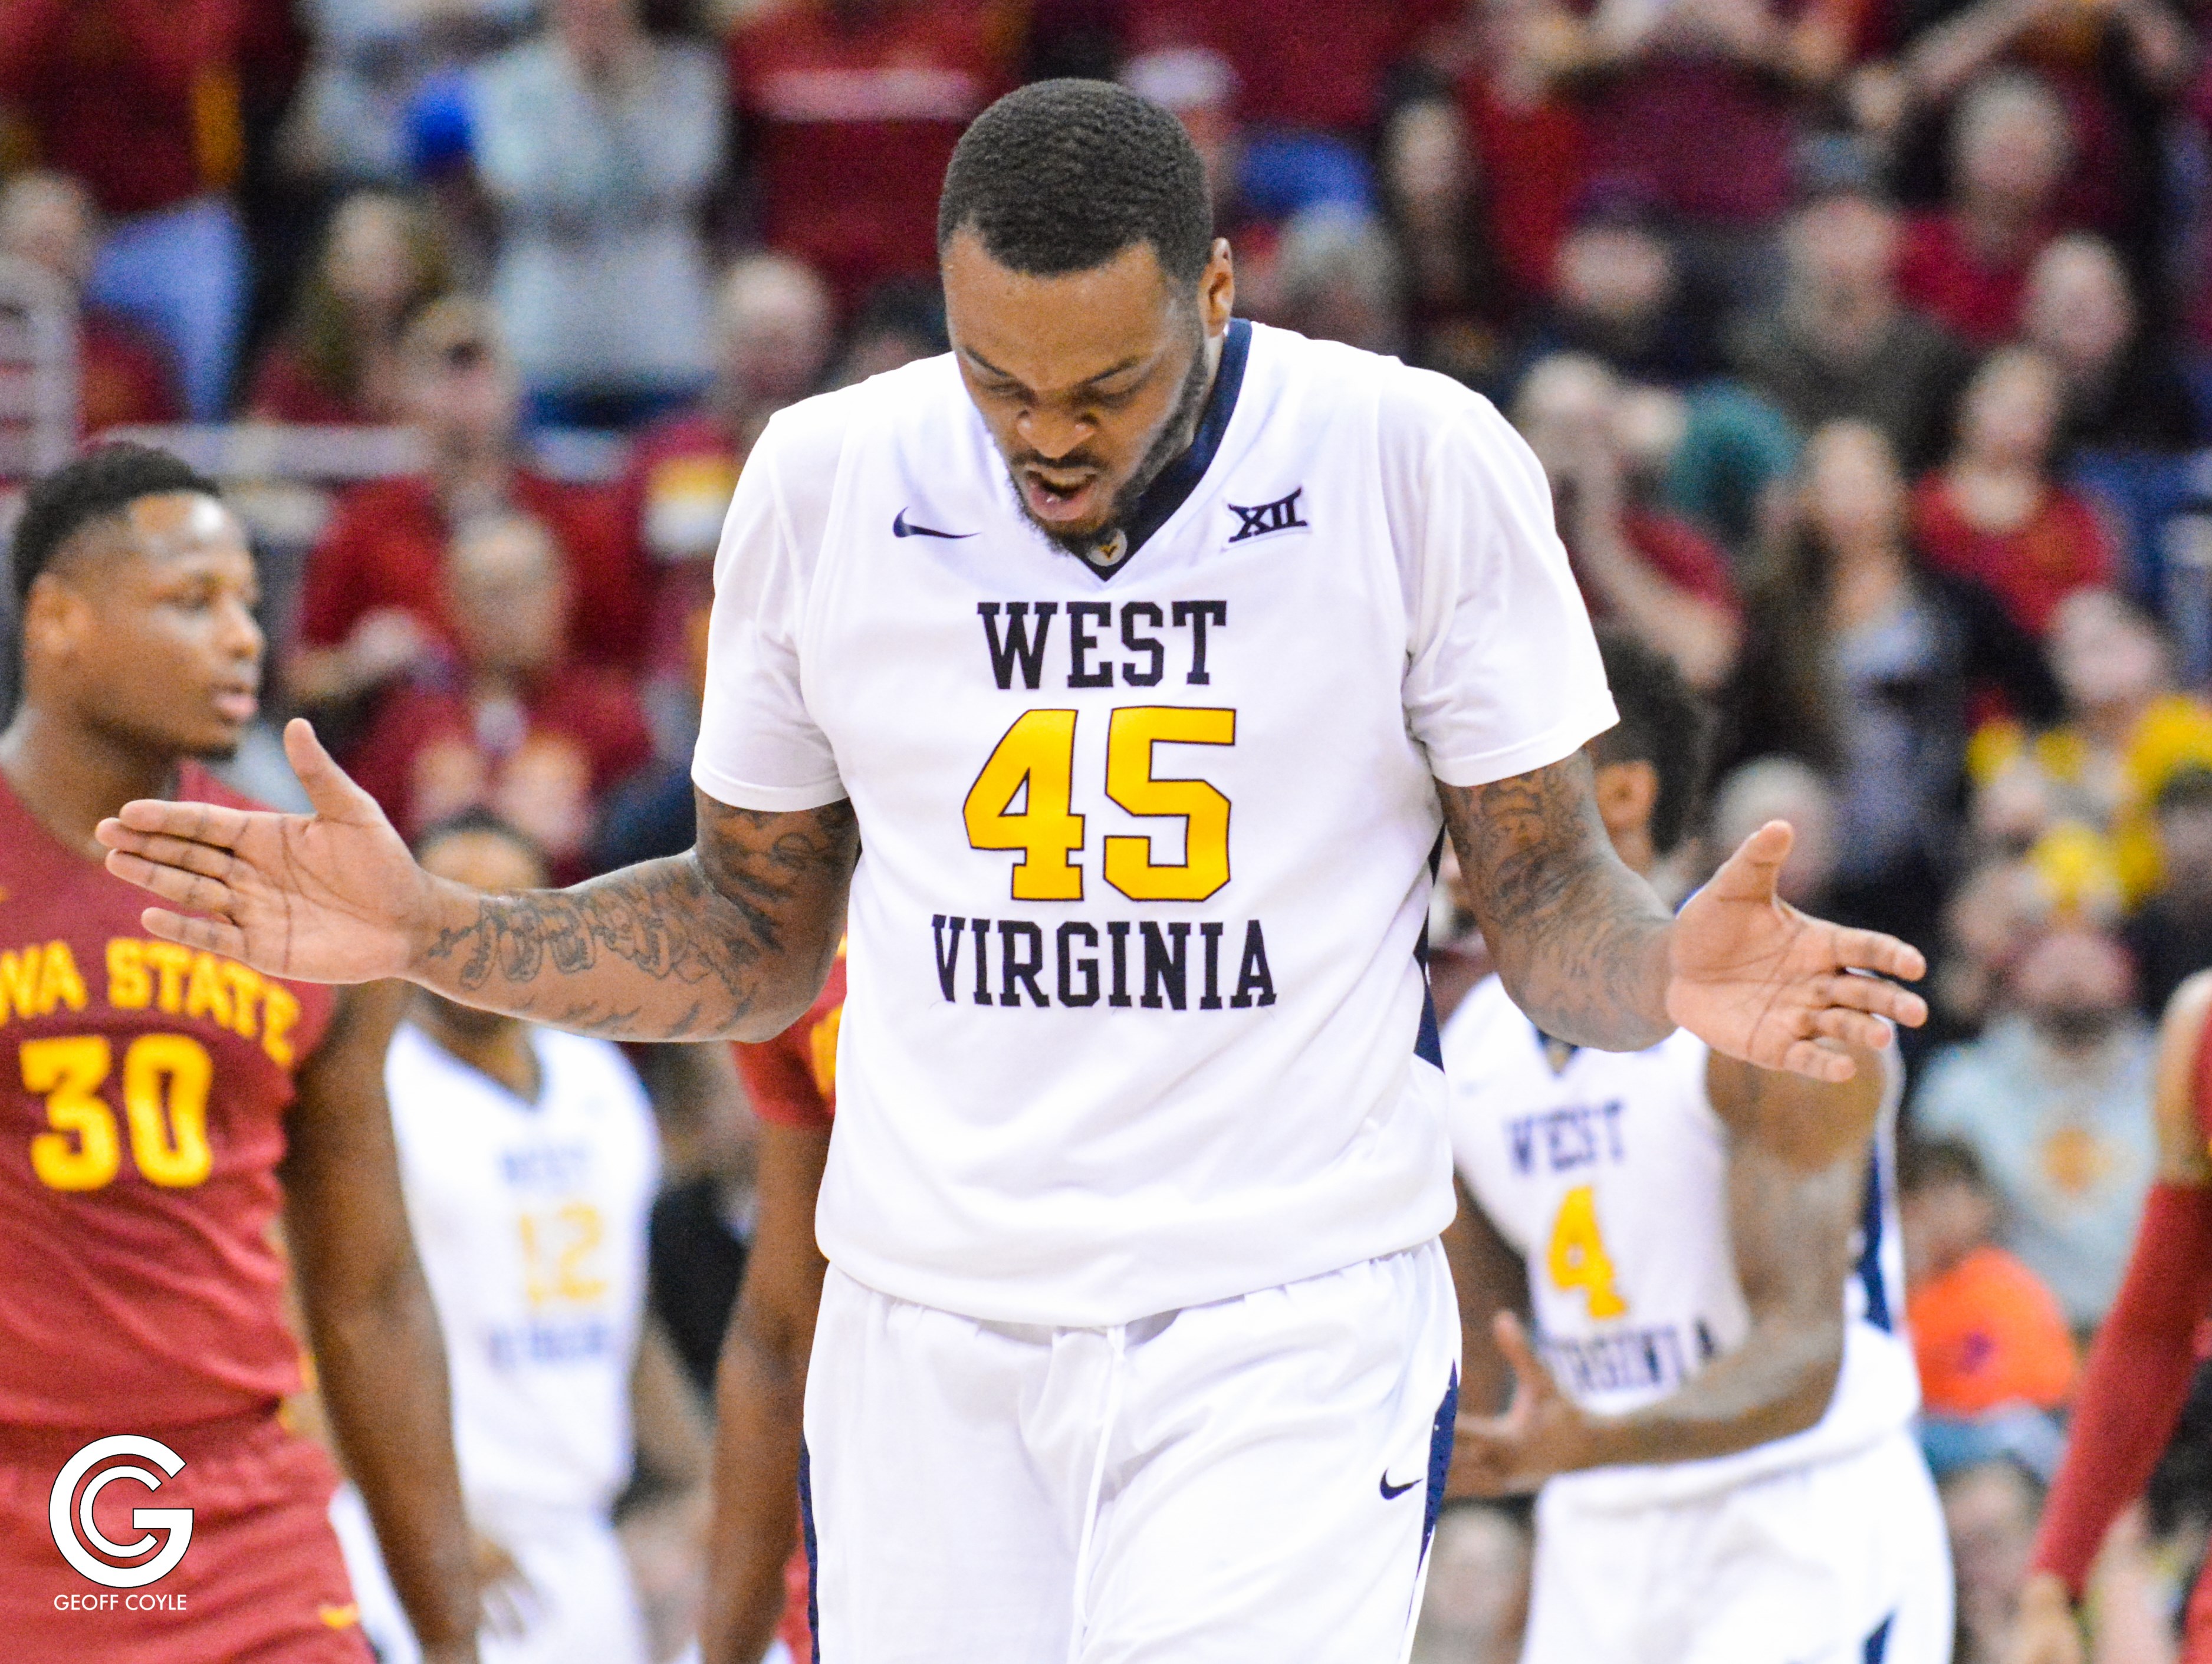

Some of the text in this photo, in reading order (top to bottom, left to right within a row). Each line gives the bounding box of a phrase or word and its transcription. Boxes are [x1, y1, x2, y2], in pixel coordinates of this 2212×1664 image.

[1228, 487, 1307, 542] XII
[977, 600, 1227, 690] WEST
[962, 705, 1237, 902] 45
[106, 936, 301, 1067] STATE
[932, 914, 1278, 1010] VIRGINIA
[19, 1032, 213, 1192] 30
[1501, 1100, 1626, 1175] WEST
[519, 1200, 610, 1306] 12
[1546, 1185, 1628, 1320] 4
